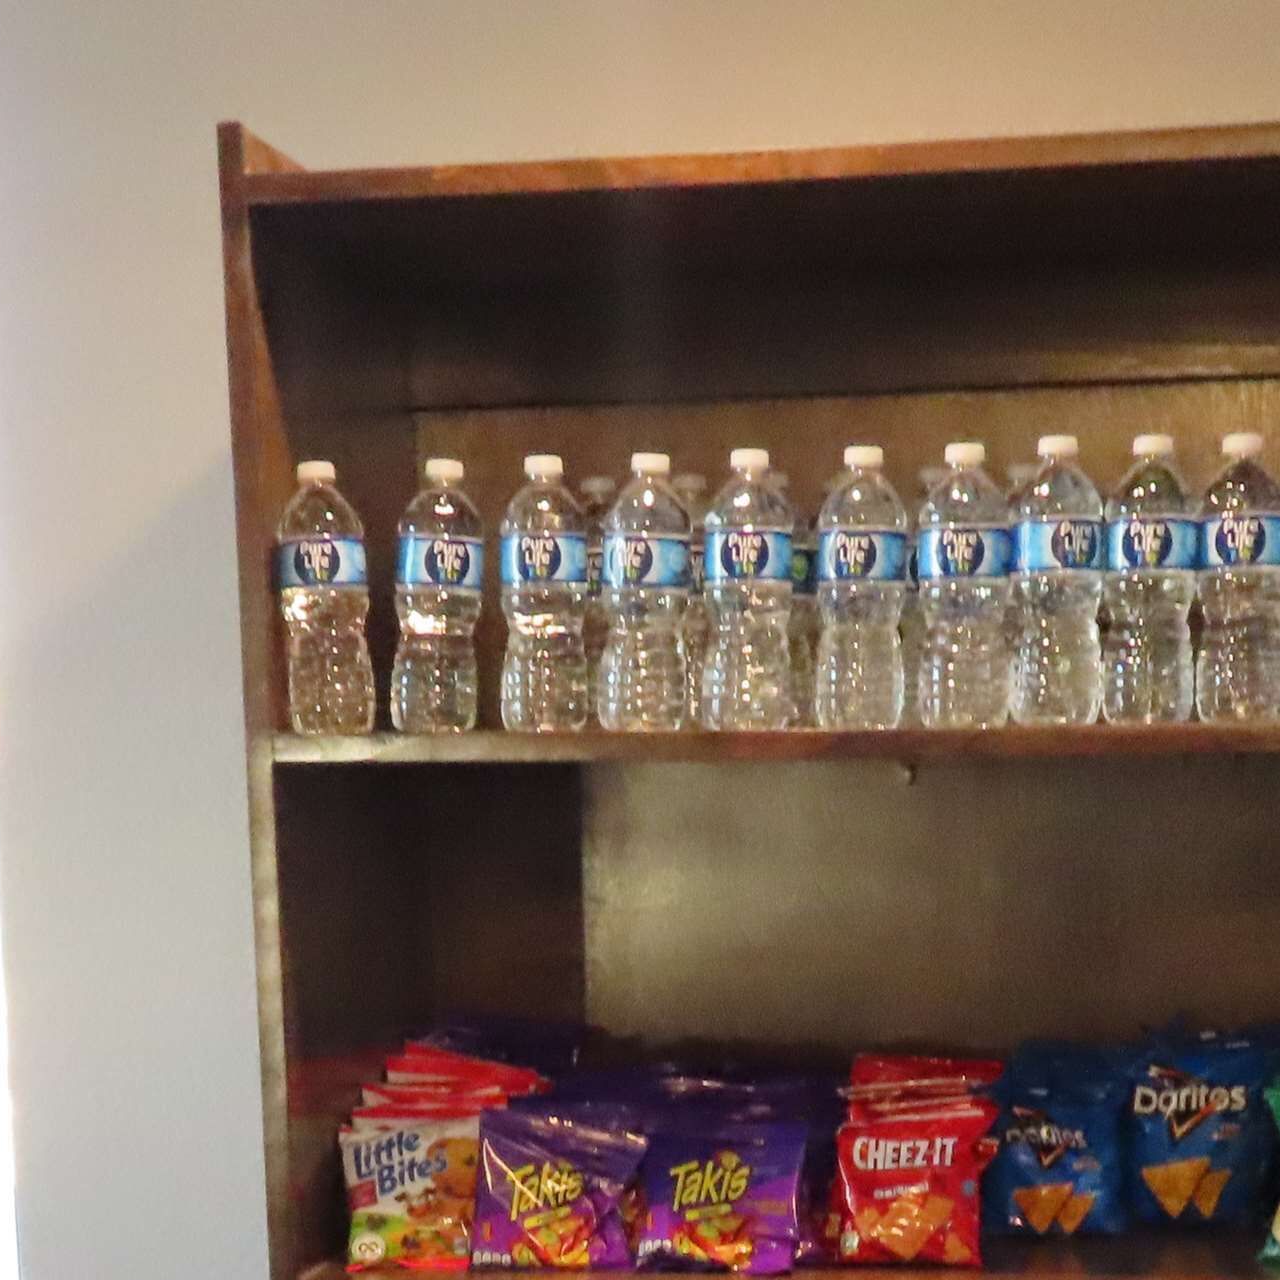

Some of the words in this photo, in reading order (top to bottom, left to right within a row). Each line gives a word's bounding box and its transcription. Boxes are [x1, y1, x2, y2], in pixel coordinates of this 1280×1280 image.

[1134, 1082, 1247, 1117] Doritos
[353, 1131, 420, 1179] Little
[378, 1150, 448, 1195] Bites
[507, 1159, 585, 1221] Takis
[671, 1152, 751, 1212] Takis
